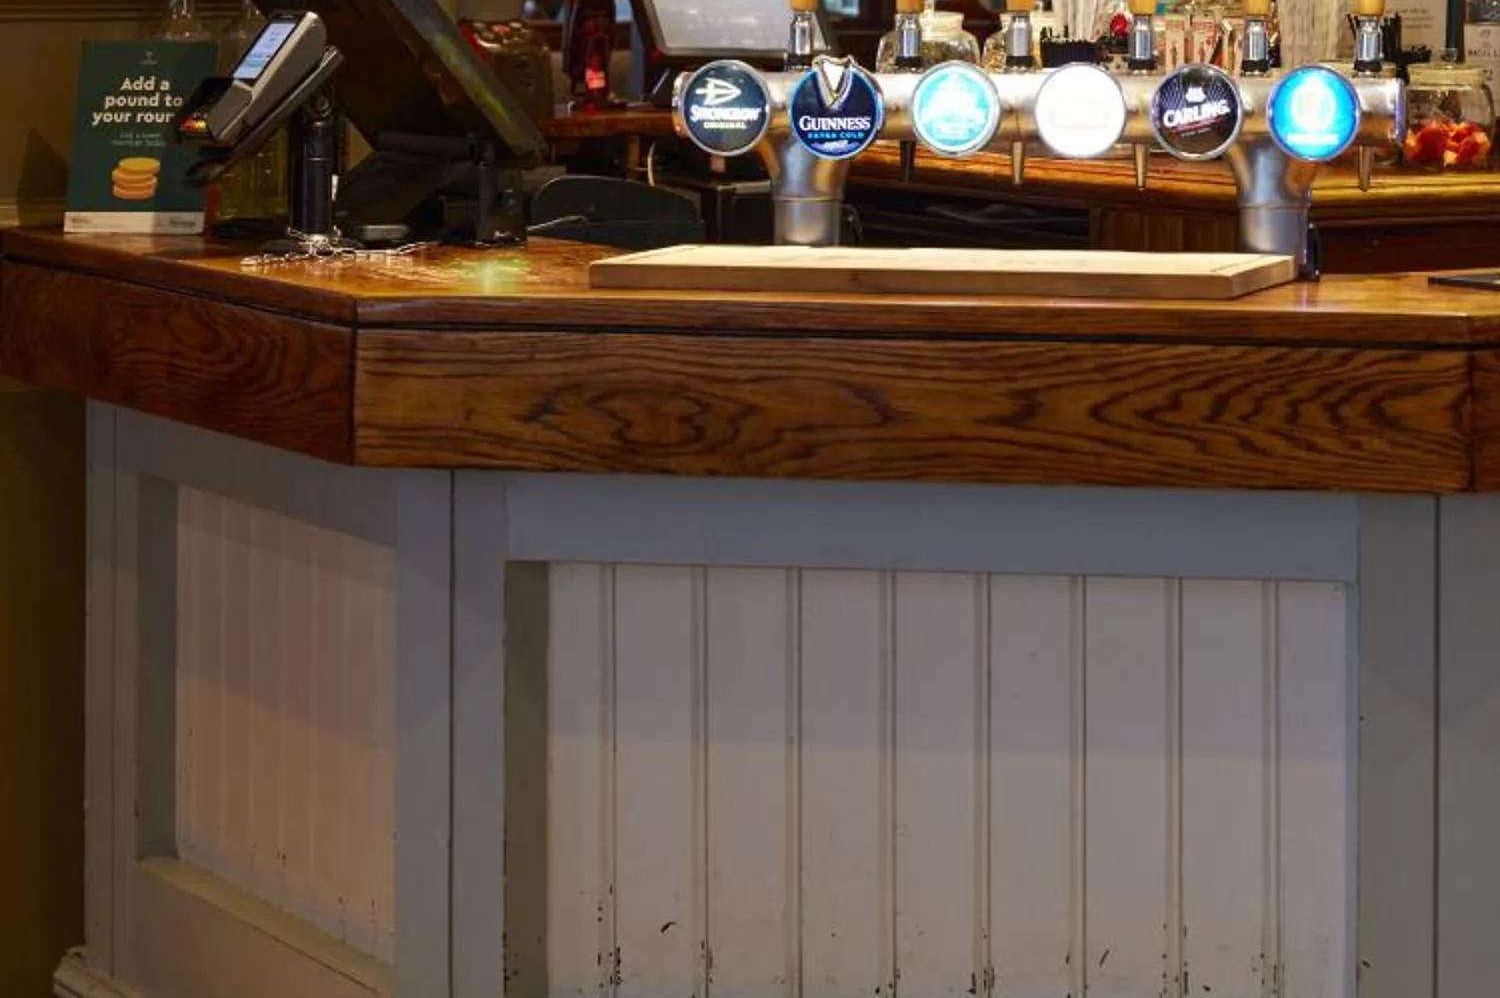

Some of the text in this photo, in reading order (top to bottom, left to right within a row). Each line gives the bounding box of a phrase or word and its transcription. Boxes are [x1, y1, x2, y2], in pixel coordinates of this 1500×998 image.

[120, 75, 170, 91] Add a
[105, 92, 184, 110] pound to
[91, 112, 132, 127] your
[1163, 99, 1231, 128] CARLING
[799, 115, 871, 131] GUINNESS
